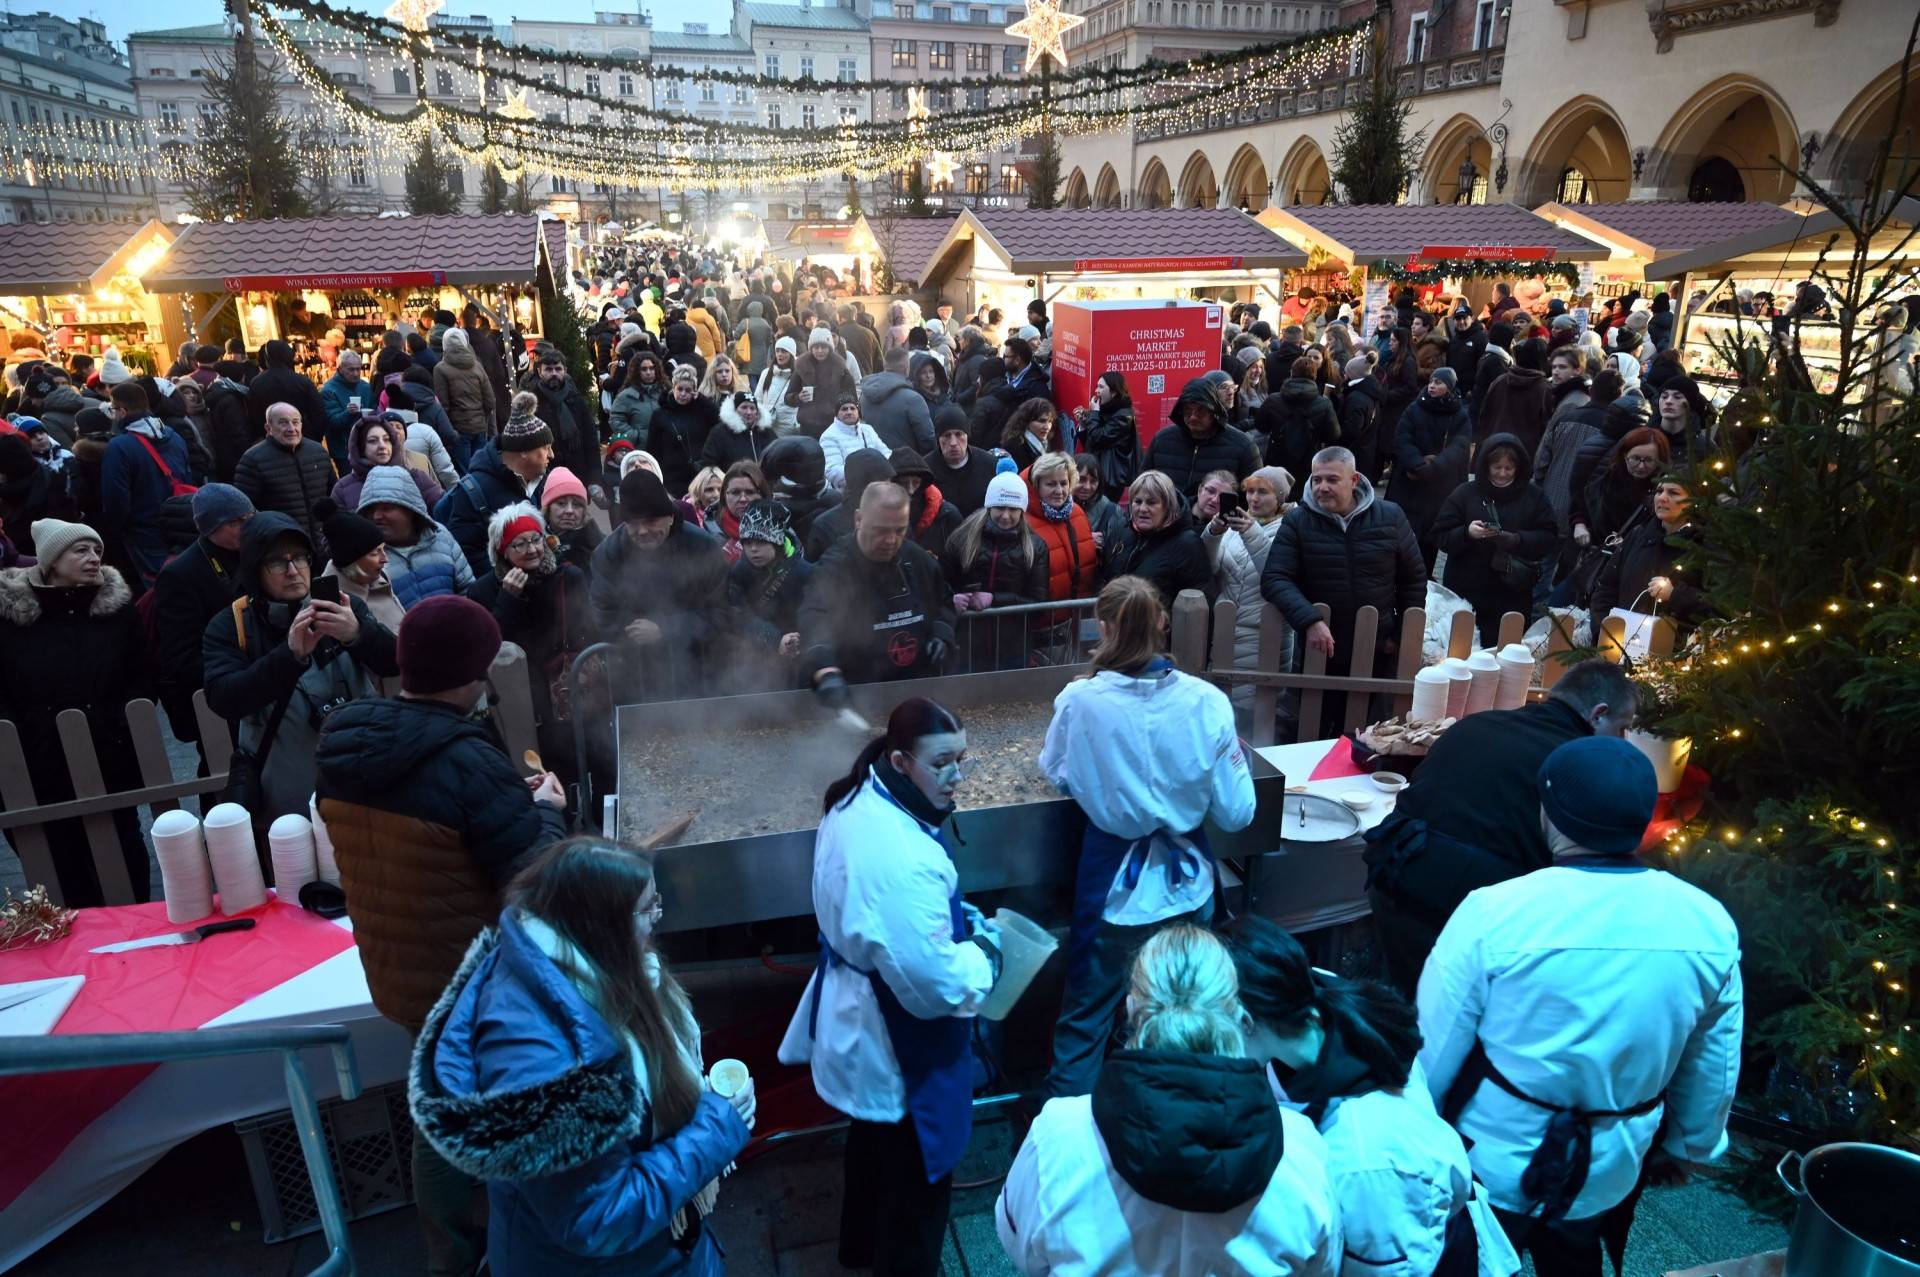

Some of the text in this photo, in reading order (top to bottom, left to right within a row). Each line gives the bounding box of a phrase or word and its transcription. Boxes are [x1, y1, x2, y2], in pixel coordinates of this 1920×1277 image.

[285, 276, 393, 287] WINA, CYDRY, MIODY PITNE
[1129, 328, 1185, 340] CHRISTMAS
[1137, 341, 1178, 352] MARKET
[1135, 353, 1153, 361] MAIN
[1154, 351, 1181, 360] MARKET
[1181, 350, 1206, 359] SQUARE
[1106, 359, 1206, 372] 28.11.2025-01.01.2026
